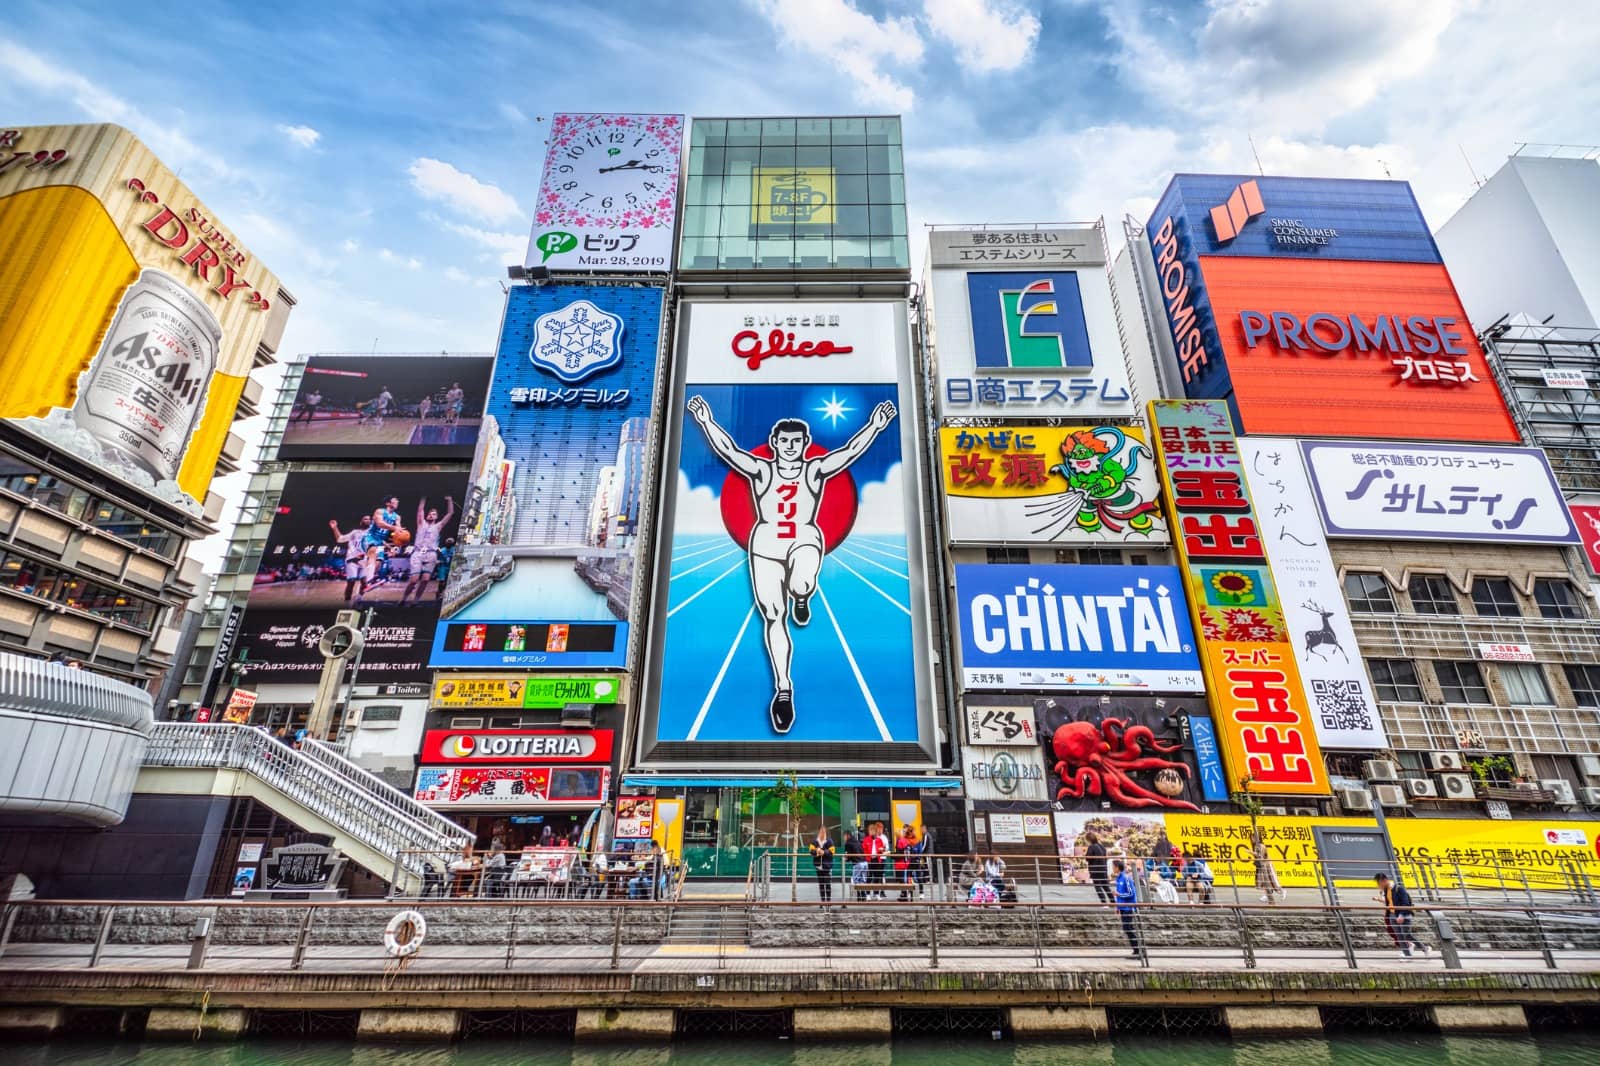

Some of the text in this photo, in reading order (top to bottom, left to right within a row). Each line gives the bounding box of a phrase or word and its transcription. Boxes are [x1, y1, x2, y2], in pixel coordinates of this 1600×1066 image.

[586, 135, 602, 147] 11
[608, 132, 625, 144] 12
[633, 137, 644, 147] 1
[566, 146, 585, 160] 10
[645, 149, 660, 159] 2
[559, 164, 574, 174] 9
[562, 180, 578, 191] 8
[643, 181, 656, 192] 4
[579, 192, 594, 203] 7
[602, 196, 613, 208] 6
[625, 192, 637, 204] 5
[1271, 218, 1303, 228] SMBC
[186, 207, 245, 268] SUPER
[972, 233, 1059, 245] 夢ある住まい
[1273, 227, 1339, 237] CONSUMER
[1277, 235, 1329, 245] FINANCE
[583, 233, 640, 252] ピップ
[578, 255, 665, 266] Mar. 28, 2019
[959, 248, 1077, 261] エステムシリーズ
[1153, 215, 1207, 384] PROMISE
[1239, 310, 1469, 355] PROMISE
[111, 331, 202, 406] Asahi
[1391, 355, 1481, 383] プロミス
[509, 387, 630, 403] 雪印メグミルク
[946, 377, 1130, 403] 日商エステム
[132, 386, 161, 415] 生
[113, 397, 167, 432] スーパードライ
[118, 429, 143, 449] 350ml
[955, 430, 1036, 450] かぜに
[1160, 426, 1231, 440] 日本一
[1162, 440, 1237, 454] 安売王
[1166, 455, 1240, 468] スーパー
[1351, 453, 1514, 470] 総合不動産のプロデューサー
[948, 453, 1050, 487] 改源
[1253, 450, 1318, 547] はちかん
[1382, 482, 1504, 516] サムティ
[776, 481, 800, 539] グリコ
[1172, 470, 1265, 560] 玉出
[971, 577, 1182, 654] CHINTAI
[369, 627, 417, 635] ANYTIME
[214, 611, 240, 670] TSUTAYA
[1222, 648, 1281, 665] スーパー
[971, 673, 1005, 684] 天気予報
[397, 685, 421, 694] Toilets
[980, 710, 1022, 739] くくる
[1180, 715, 1190, 740] 2F
[1228, 669, 1314, 784] 玉出
[1457, 731, 1482, 745] BAR
[480, 738, 582, 755] LOTTERIA
